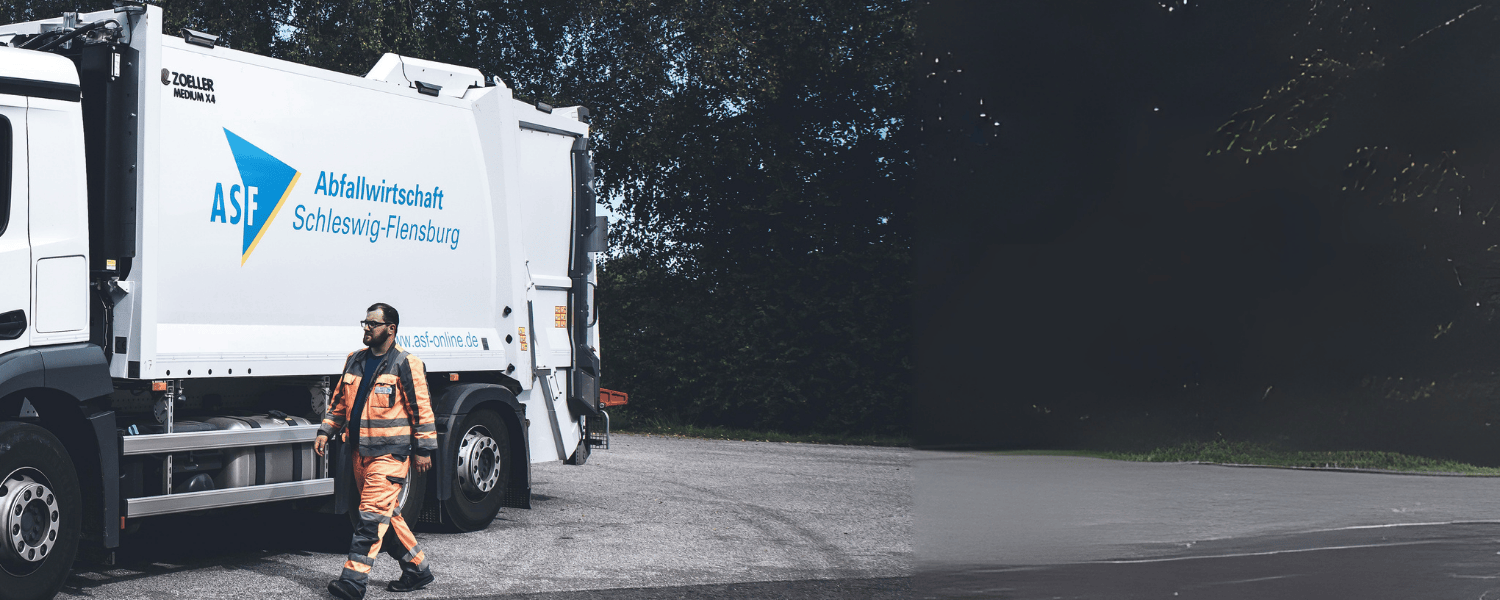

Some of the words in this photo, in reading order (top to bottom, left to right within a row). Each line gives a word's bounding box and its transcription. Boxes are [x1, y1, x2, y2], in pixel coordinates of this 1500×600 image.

[172, 71, 215, 92] ZOELLER
[173, 87, 204, 102] MEDIUM
[210, 182, 258, 226] ASF
[314, 170, 444, 210] Abfallwirtschaft
[292, 204, 460, 250] Schleswig-Flensburg
[395, 331, 479, 348] ww.asf-online.de
